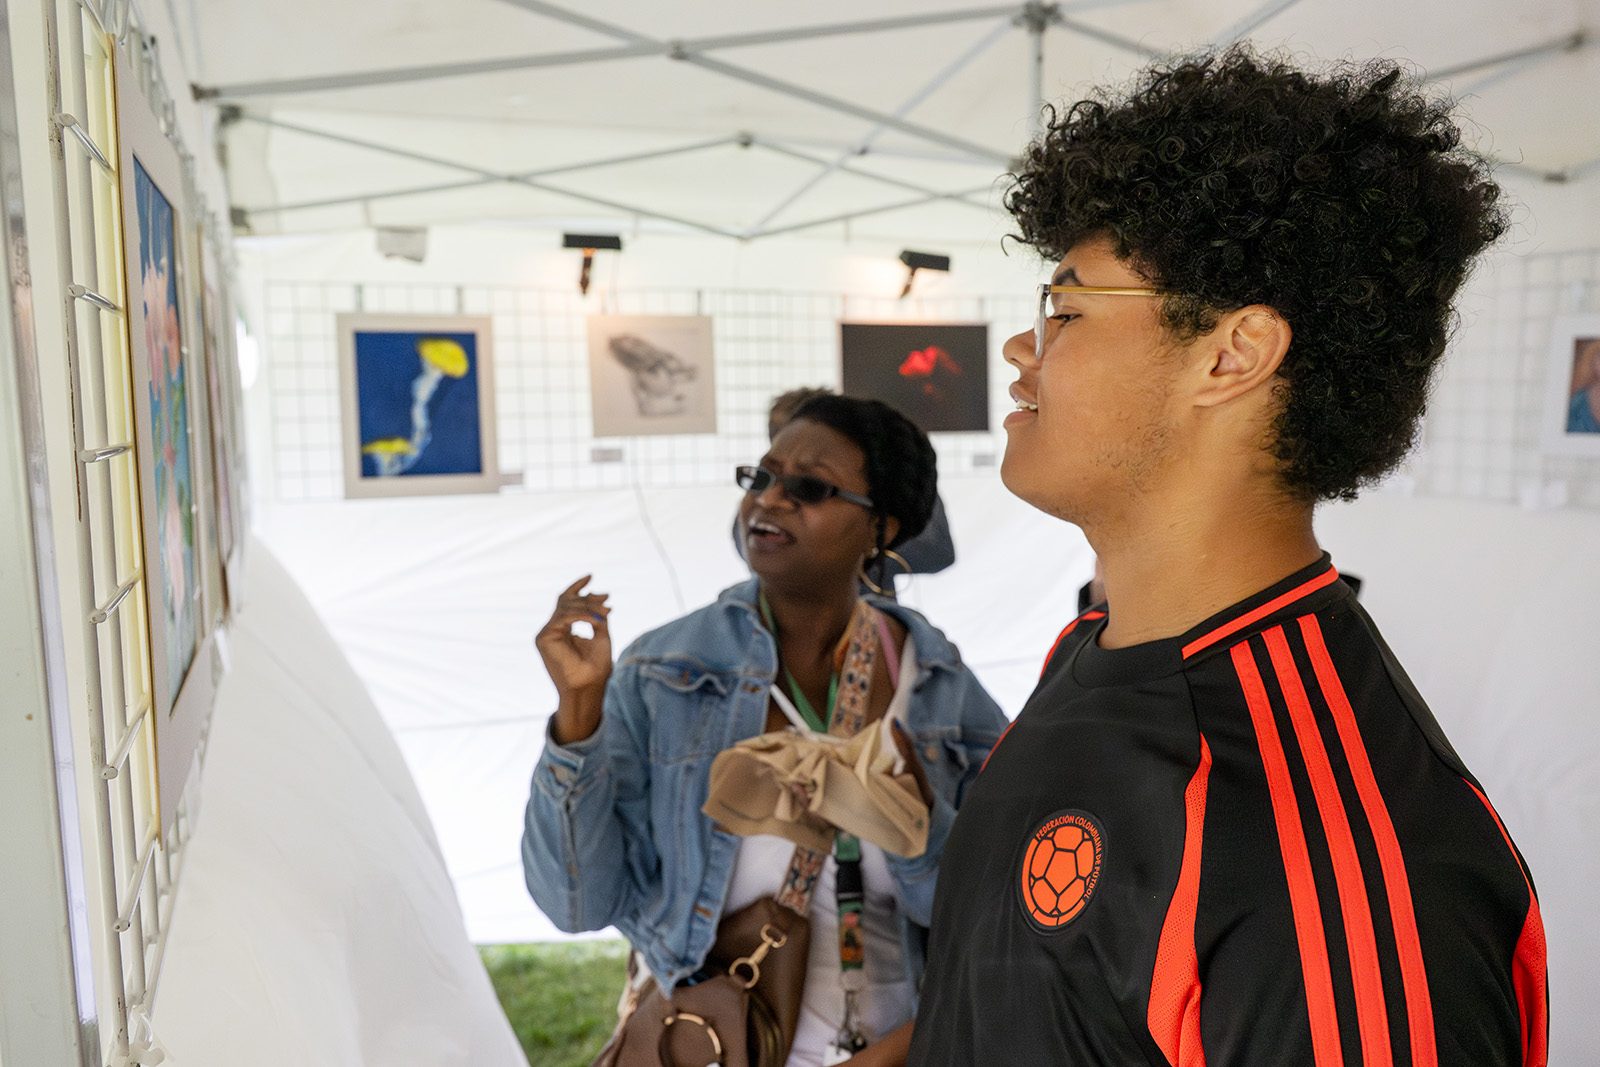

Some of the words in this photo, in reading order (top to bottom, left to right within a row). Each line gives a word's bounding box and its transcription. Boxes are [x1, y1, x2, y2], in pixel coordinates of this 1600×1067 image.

[1036, 815, 1074, 840] FEDERACIÓN
[1075, 816, 1102, 853] COLOMBIANA
[1095, 853, 1102, 865] DE
